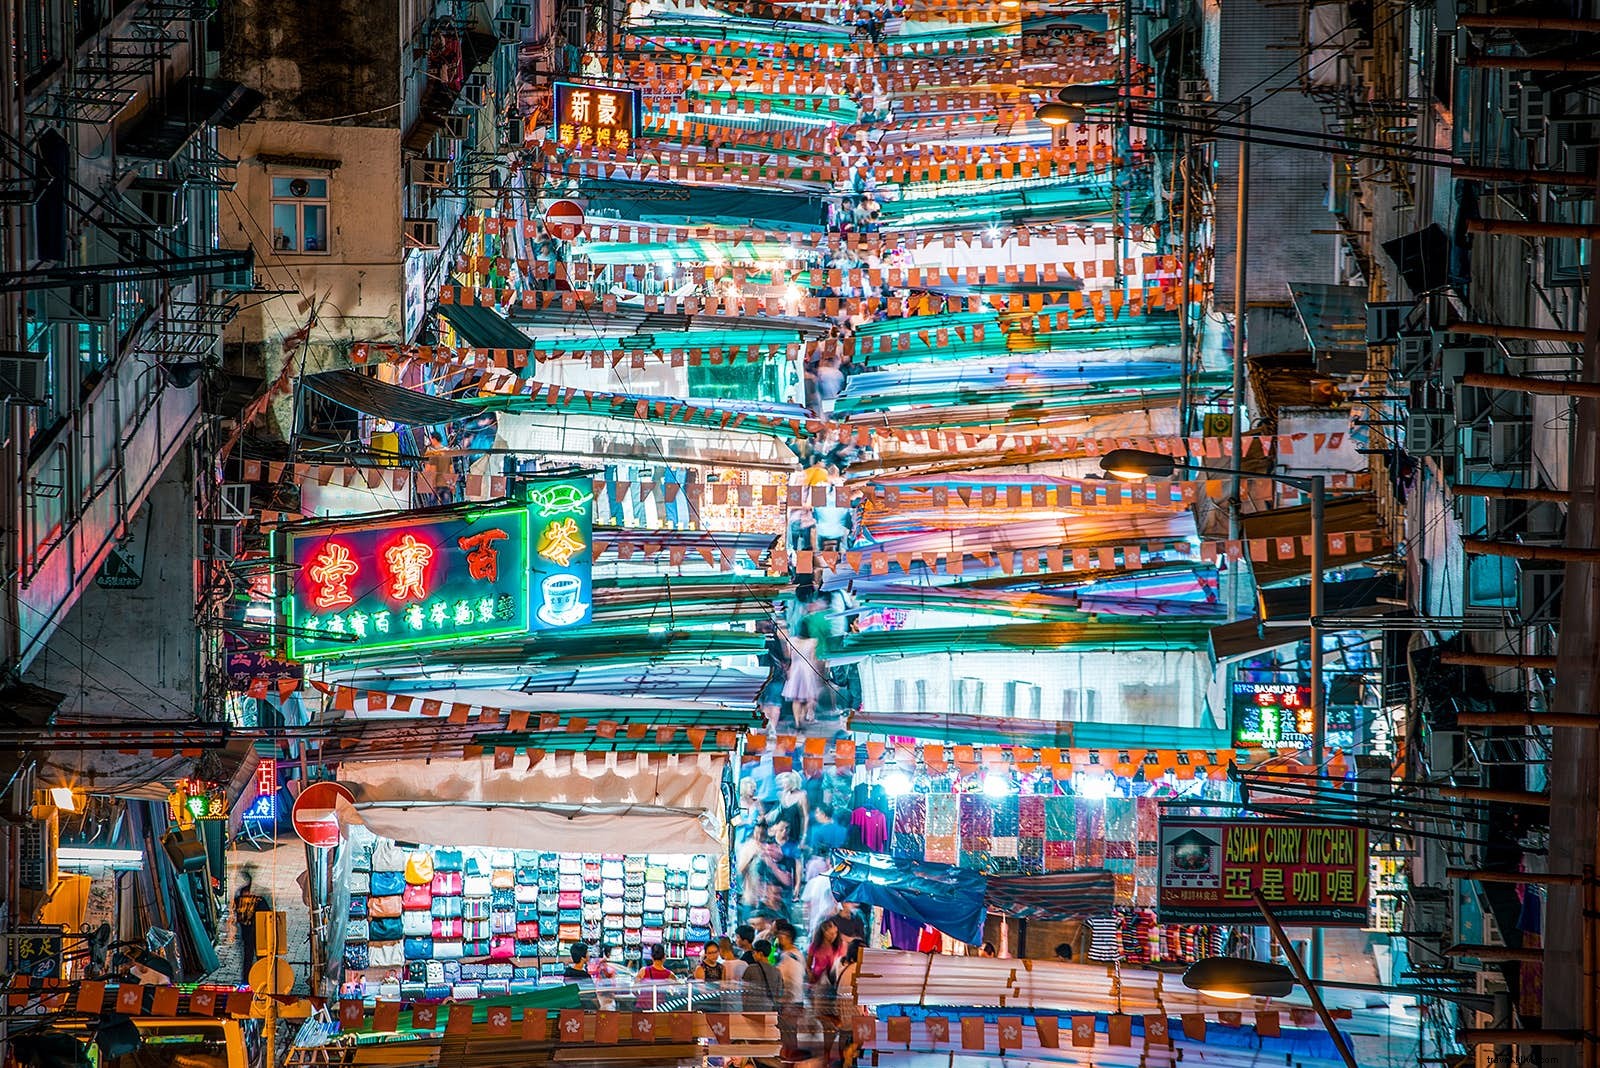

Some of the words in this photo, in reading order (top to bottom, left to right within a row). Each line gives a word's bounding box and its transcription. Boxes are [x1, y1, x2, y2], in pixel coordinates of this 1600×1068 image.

[571, 91, 617, 125] 新豪
[1225, 827, 1260, 863] ASIAN
[1264, 827, 1300, 864] CURRY
[1306, 828, 1354, 865] KITCHEN
